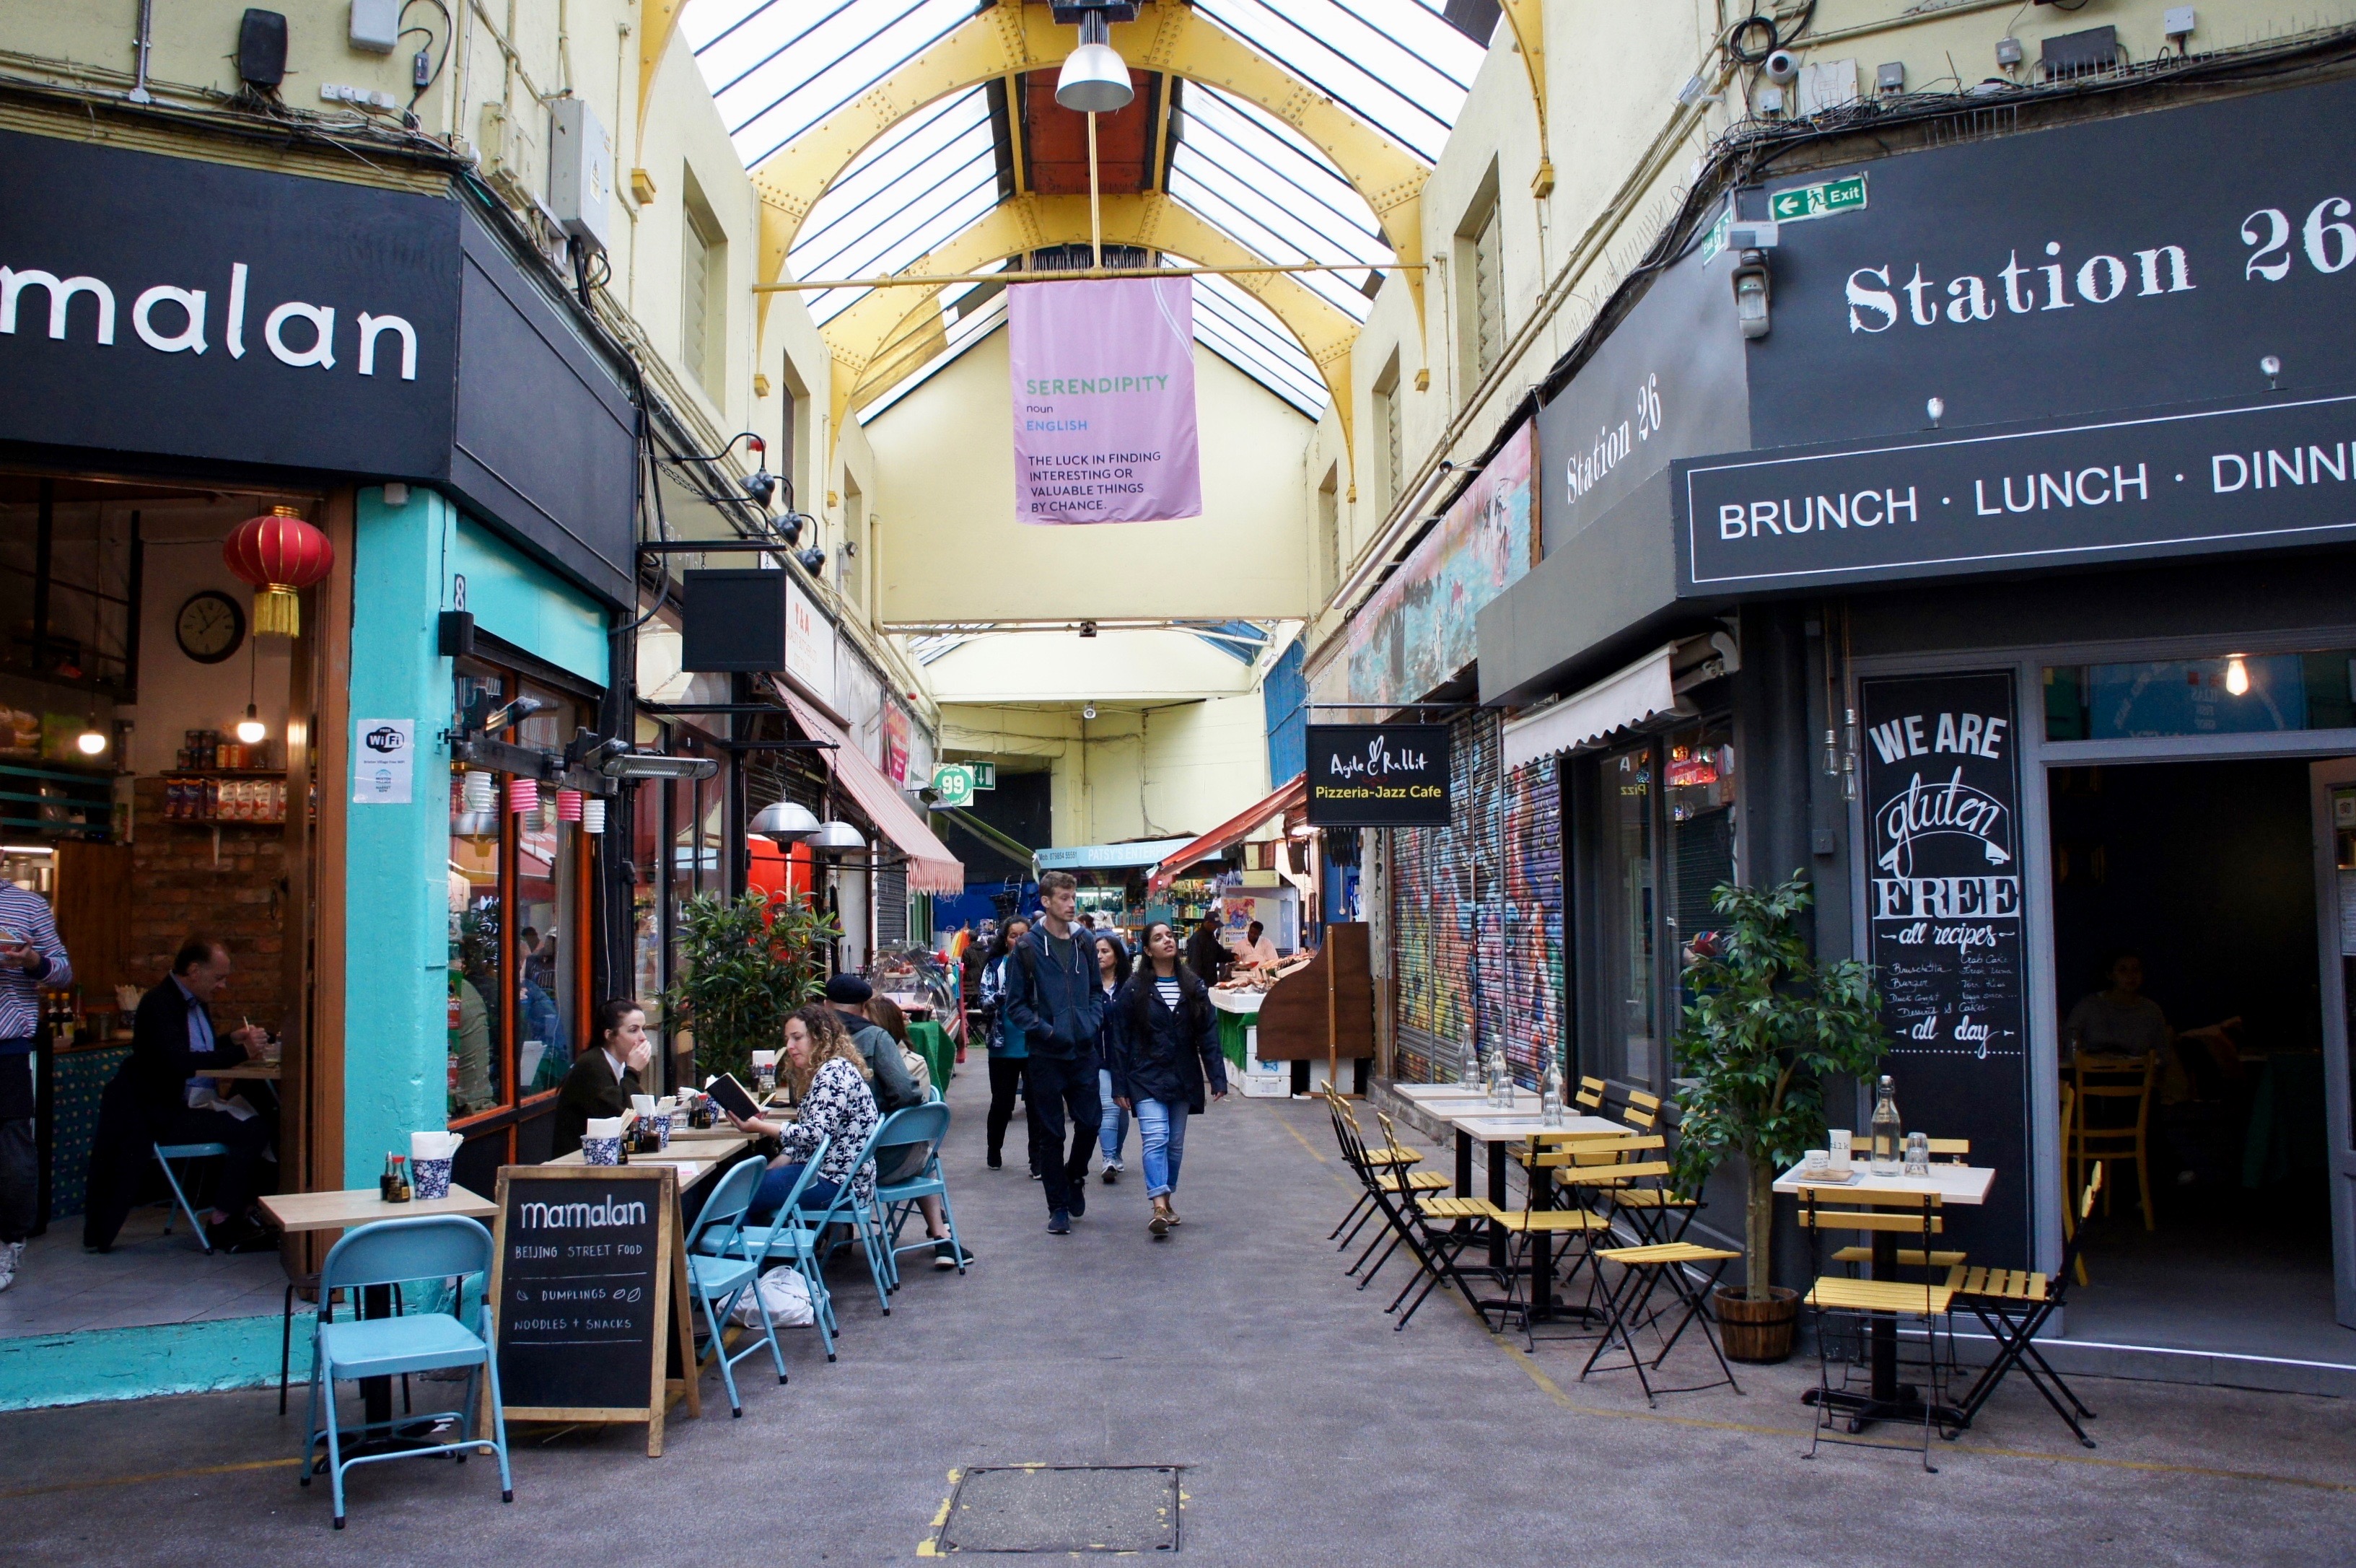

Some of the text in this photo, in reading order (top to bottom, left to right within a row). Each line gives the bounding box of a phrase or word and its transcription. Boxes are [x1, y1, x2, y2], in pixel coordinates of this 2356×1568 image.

[1830, 186, 1860, 203] Exit
[1703, 237, 1714, 253] Exit
[1844, 197, 2356, 336] Station 26
[0, 263, 416, 380] malan
[1027, 375, 1169, 395] SERENDIPITY
[1027, 405, 1054, 413] noun
[1027, 420, 1087, 432] ENGLISH
[1567, 372, 1661, 505] Station 26
[1028, 452, 1161, 466] THE LUCK IN FINDING
[1030, 468, 1133, 482] INTERESTING OR
[1030, 483, 1144, 497] VALUABLE THINGS
[1719, 441, 2356, 540] BRUNCH LUNCH DINN
[1031, 500, 1107, 513] BY CHANCE.
[455, 577, 464, 611] 8
[1869, 713, 2007, 764] WE ARE
[1331, 748, 1429, 779] Agile Rabbit
[942, 775, 964, 794] 99
[1315, 785, 1442, 798] Pizzeria-Jazz Cafe
[1888, 766, 2000, 879] gluten
[1088, 847, 1124, 861] PATSY'S
[1872, 875, 2020, 919] FREE
[1899, 922, 1997, 954] all recipes
[1888, 960, 1951, 976] Bruschetta
[1885, 978, 1935, 992] Burger
[1911, 1015, 2000, 1059] all day
[520, 1193, 647, 1228] mamalan
[515, 1244, 642, 1259] BEIJING STREET FOOD
[542, 1288, 606, 1302] DUMPLINGS
[514, 1318, 567, 1331] NOODLES
[586, 1319, 631, 1330] SNACKS
